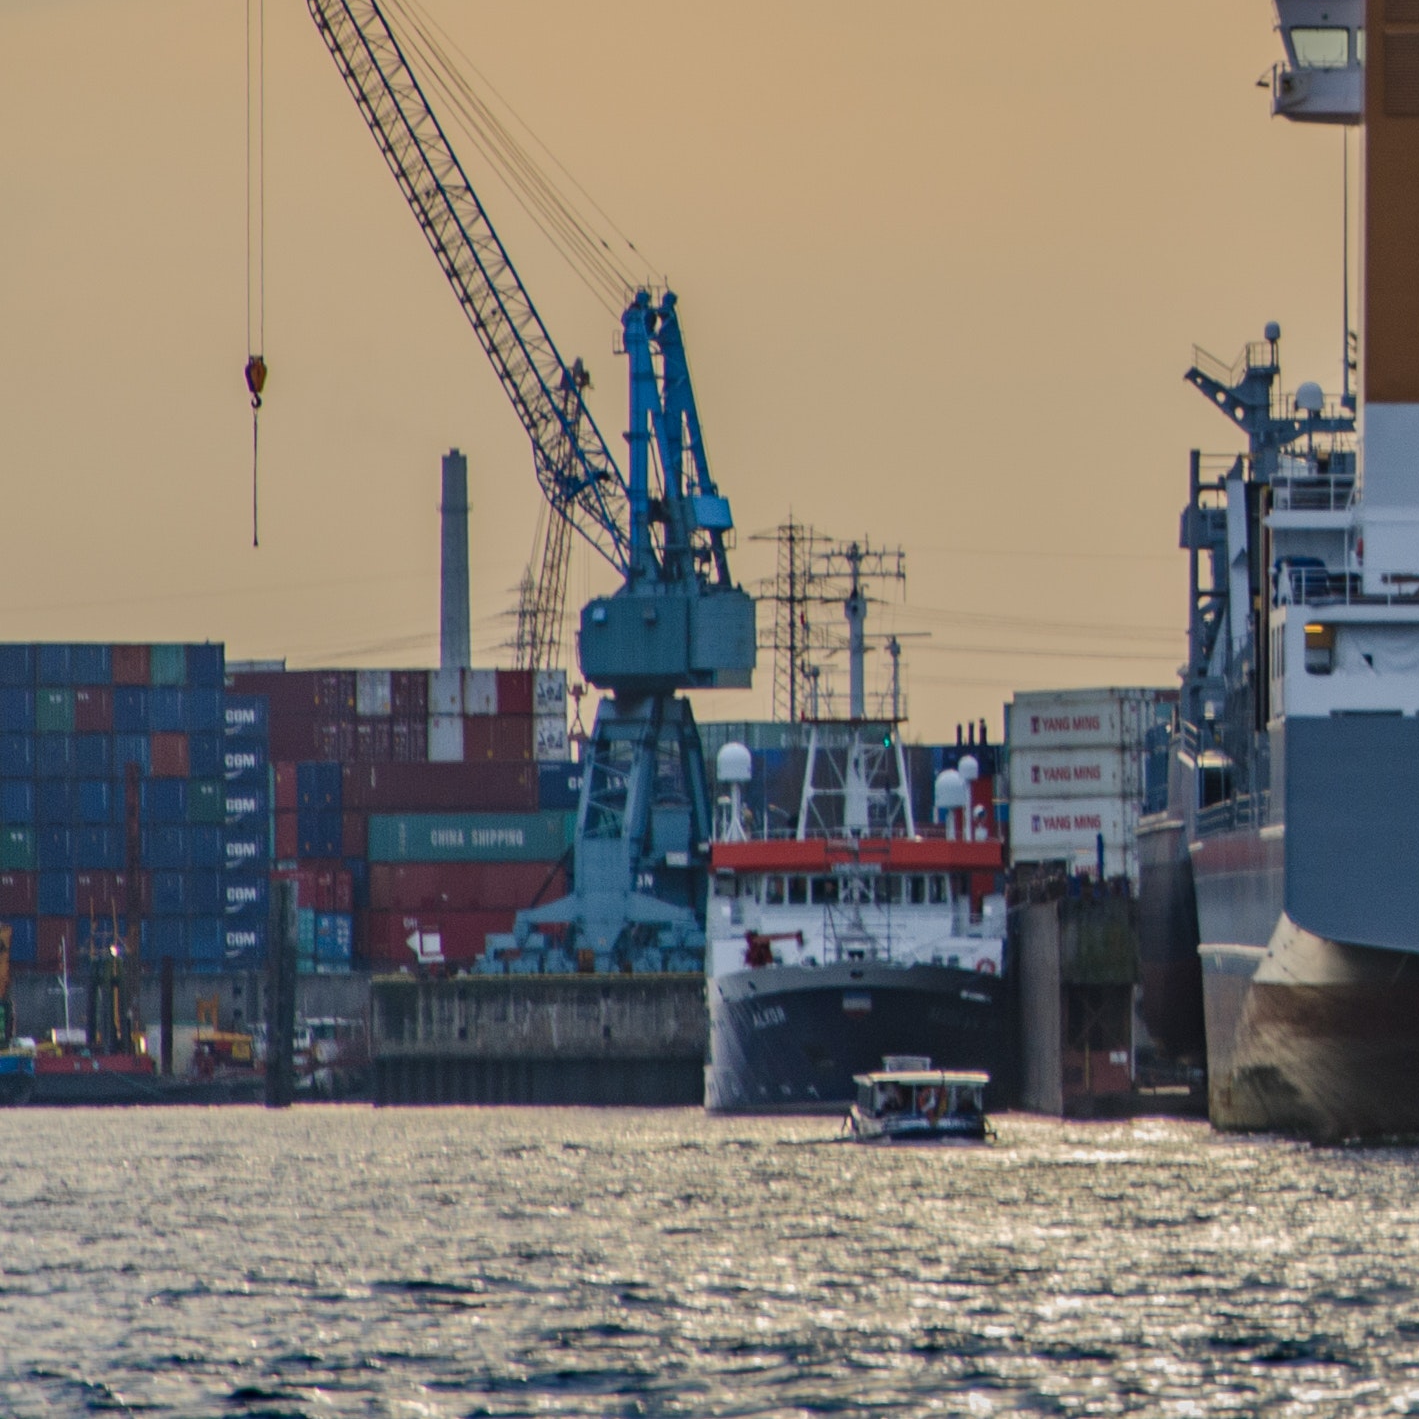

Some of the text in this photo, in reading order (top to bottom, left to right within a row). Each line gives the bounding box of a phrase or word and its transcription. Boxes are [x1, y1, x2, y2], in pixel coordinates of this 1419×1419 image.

[225, 709, 255, 723] CGM
[1042, 716, 1100, 731] YANG MING
[225, 754, 255, 768] CGM
[1042, 766, 1101, 781] YANG MING
[225, 799, 255, 813] CGM
[1043, 815, 1101, 830] YANG MING
[430, 829, 524, 847] CHINA SHIPPING
[225, 843, 256, 857] CGM
[226, 887, 256, 902] CGM
[226, 932, 256, 946] CGM
